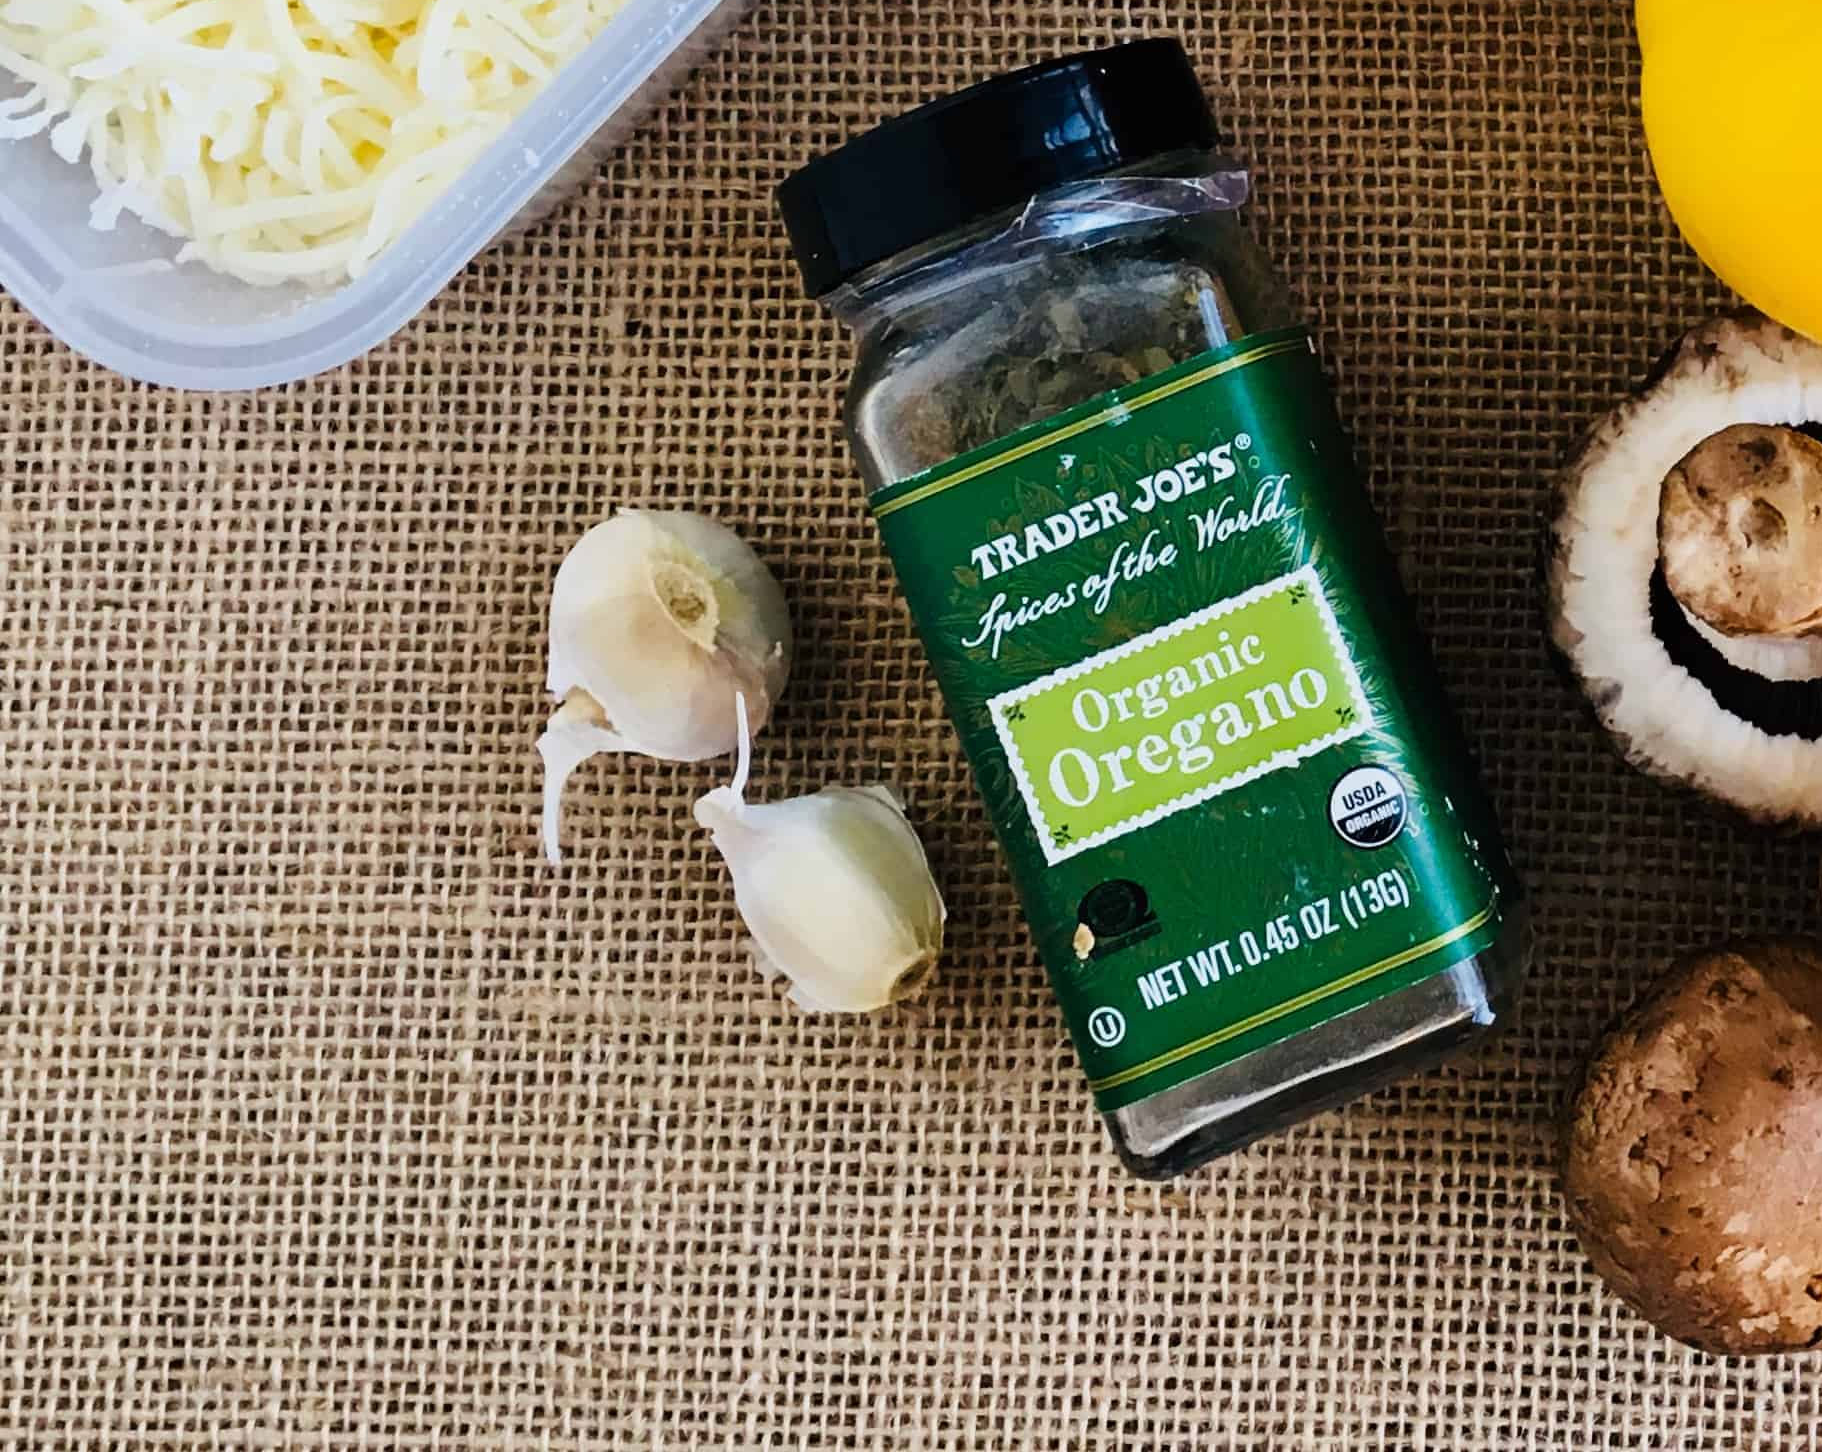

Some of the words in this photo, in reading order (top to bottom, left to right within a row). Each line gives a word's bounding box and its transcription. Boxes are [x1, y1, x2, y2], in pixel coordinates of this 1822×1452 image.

[970, 491, 1129, 581] TRADER
[961, 582, 1076, 660] Spices
[1082, 540, 1130, 614] of
[1122, 529, 1178, 581] the
[1072, 631, 1265, 733] Organic
[1049, 667, 1328, 808] Oregano
[1342, 780, 1387, 811] USDA
[1345, 798, 1401, 835] ORGANIC
[1137, 959, 1188, 1010] NET
[1188, 939, 1242, 988] WT.
[1238, 914, 1299, 966] 0.45
[1299, 897, 1340, 941] OZ
[1340, 867, 1411, 929] (13G)
